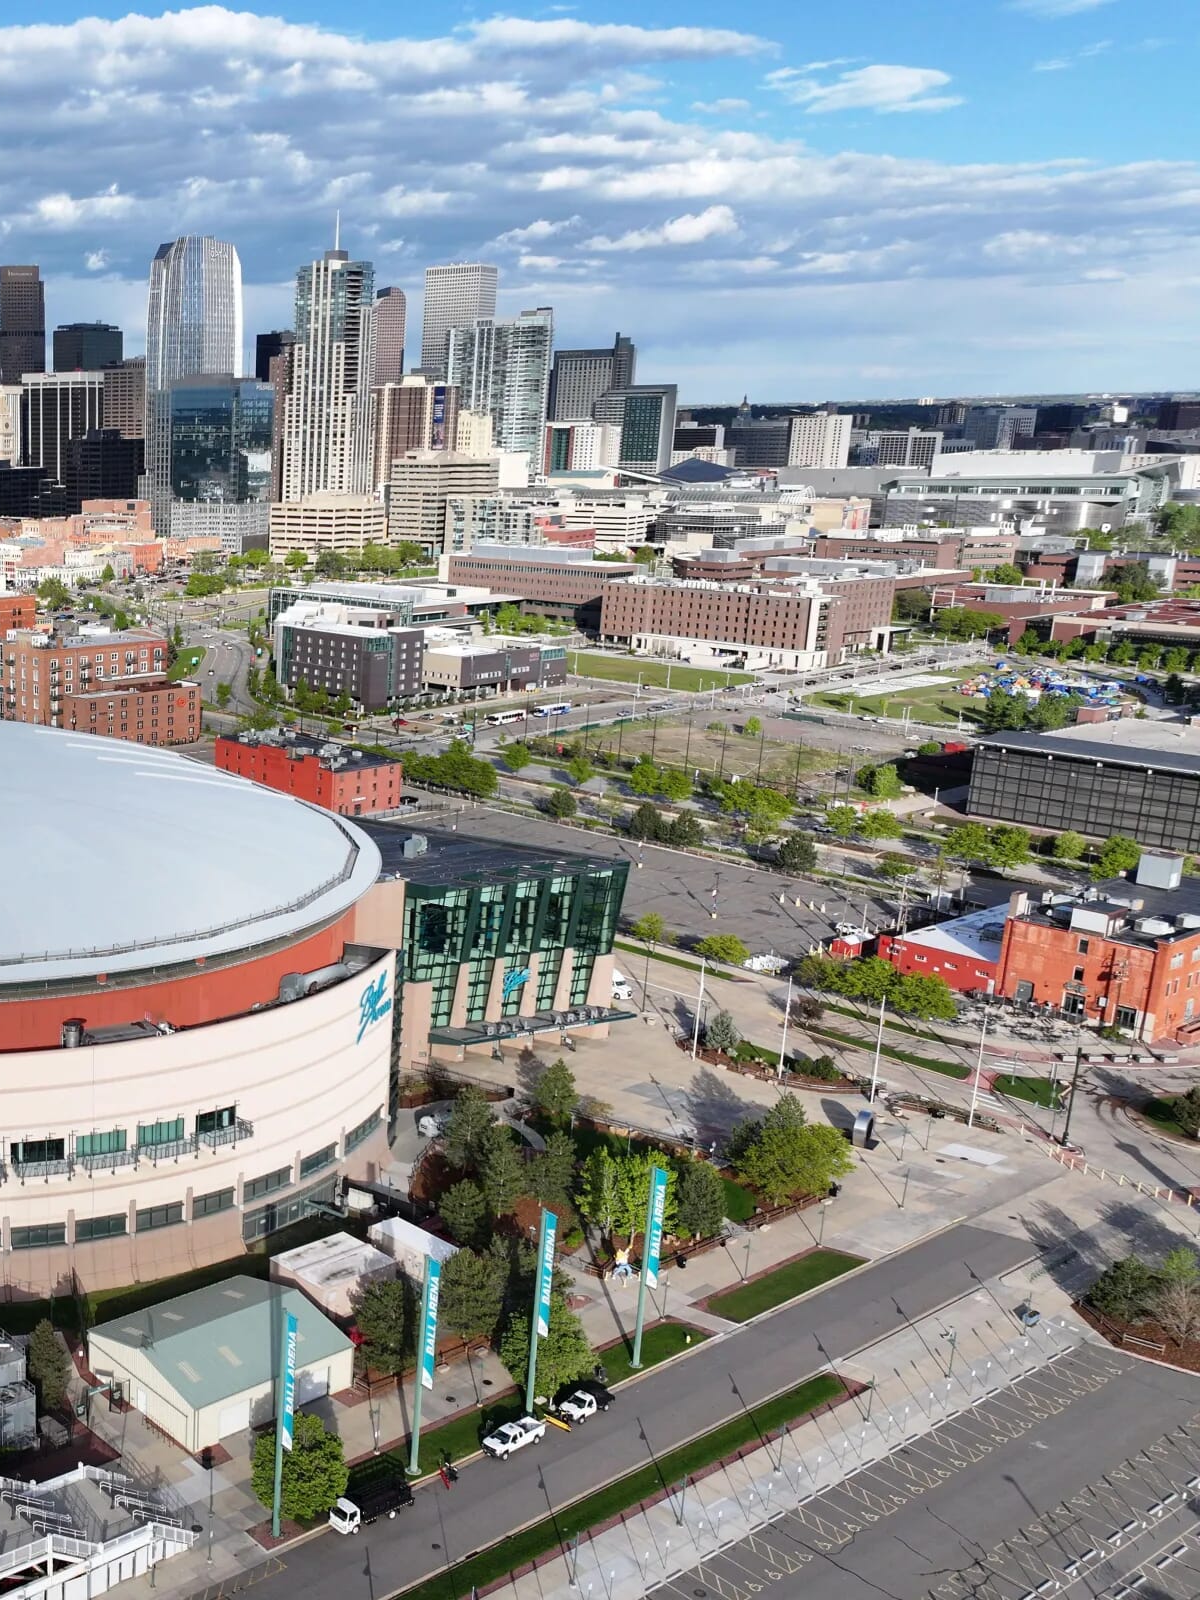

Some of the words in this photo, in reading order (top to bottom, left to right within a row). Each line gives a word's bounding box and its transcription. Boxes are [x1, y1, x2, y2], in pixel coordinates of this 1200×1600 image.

[357, 969, 388, 1036] Ball
[487, 1021, 530, 1035] BALL
[554, 1008, 610, 1025] ARENA
[654, 1185, 666, 1227] ARENA
[545, 1229, 556, 1271] ARENA
[651, 1227, 661, 1258] BALL
[428, 1276, 439, 1321] ARENA
[542, 1272, 552, 1305] BALL
[287, 1331, 297, 1379] ARENA
[426, 1322, 436, 1356] BALL
[285, 1380, 295, 1416] BALL
